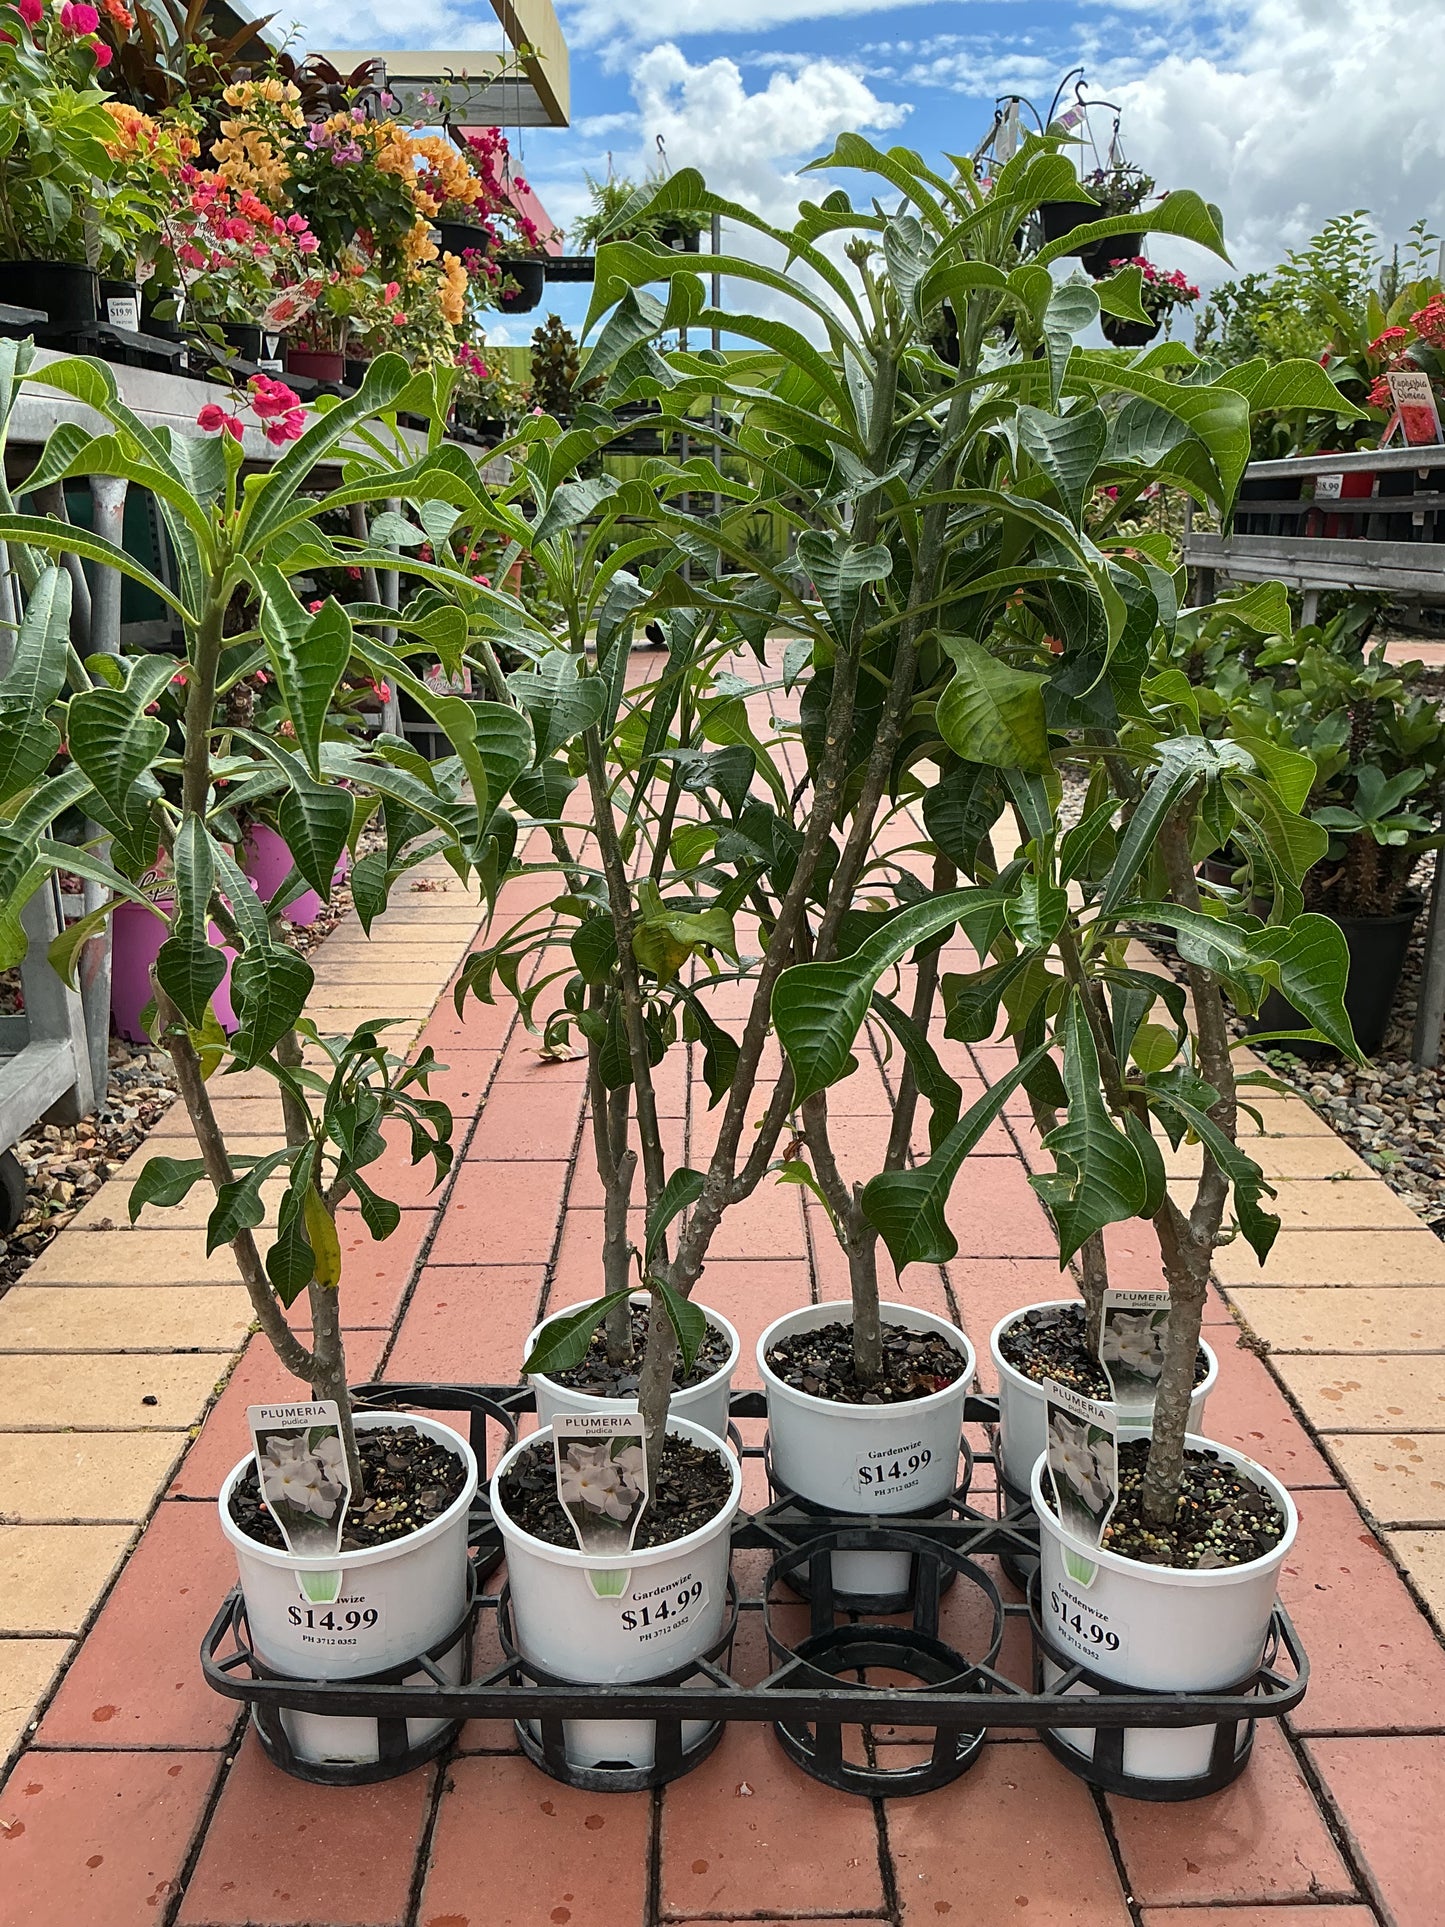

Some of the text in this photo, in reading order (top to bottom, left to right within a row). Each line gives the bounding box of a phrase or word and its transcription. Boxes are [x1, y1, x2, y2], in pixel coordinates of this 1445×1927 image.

[260, 1406, 327, 1419] PLUMERIA
[1052, 1385, 1106, 1420] PLUMERIA
[1068, 1404, 1090, 1419] pudica
[281, 1417, 309, 1427] pudica
[565, 1418, 632, 1427] PLUMERIA
[585, 1427, 613, 1435] pudica
[868, 1440, 922, 1459] Gardenwize
[858, 1449, 932, 1486] $14.99
[874, 1479, 919, 1497] PH 3712 0352
[632, 1573, 692, 1601] Gardenwize
[621, 1581, 703, 1631] $14.99
[1058, 1582, 1109, 1622] Gardenwize
[288, 1605, 379, 1631] $14.99
[639, 1616, 689, 1642] PH 3712 0352
[1051, 1590, 1120, 1651] $14.99
[302, 1634, 315, 1643] PH
[316, 1637, 336, 1645] 3712
[1067, 1635, 1082, 1650] 3712
[1082, 1646, 1100, 1661] 0352
